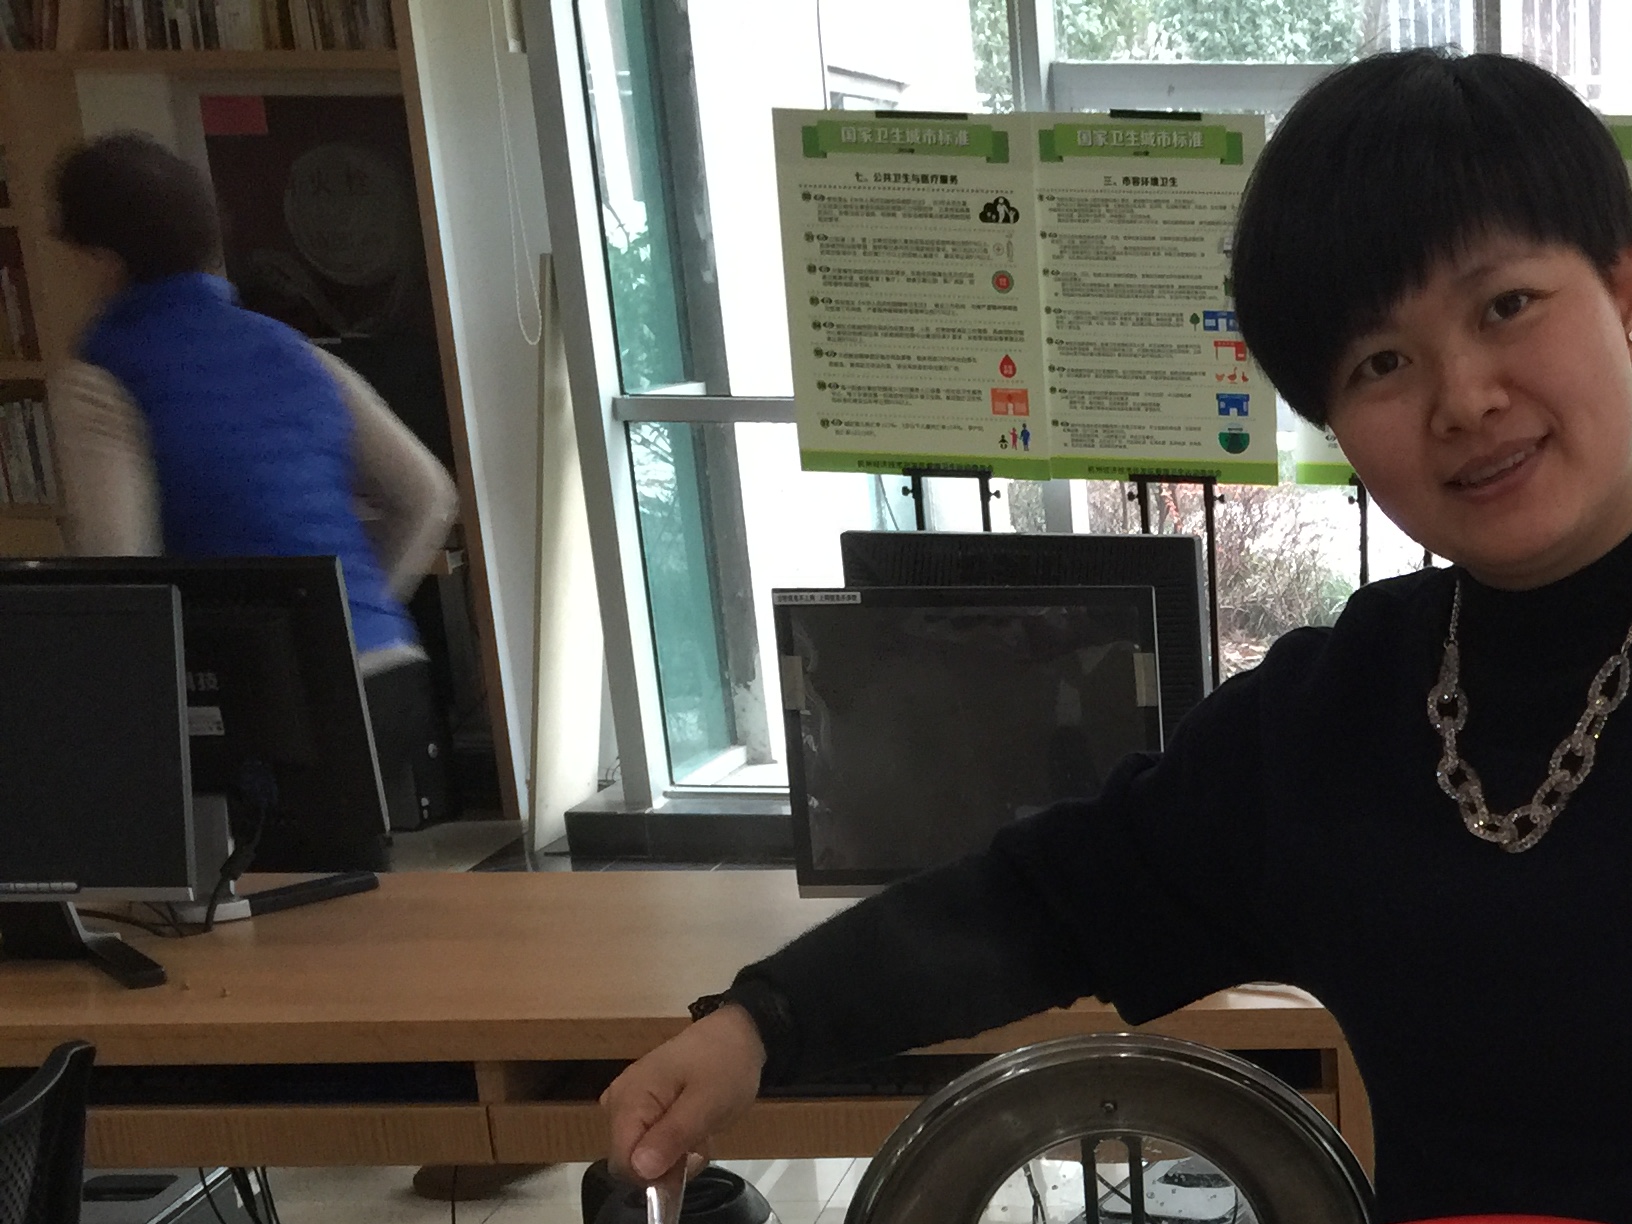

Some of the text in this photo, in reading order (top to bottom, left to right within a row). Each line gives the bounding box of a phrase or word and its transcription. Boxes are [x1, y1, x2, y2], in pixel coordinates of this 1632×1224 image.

[841, 127, 970, 147] 国家卫生城市标准
[1077, 130, 1204, 149] 国家卫生城市标准
